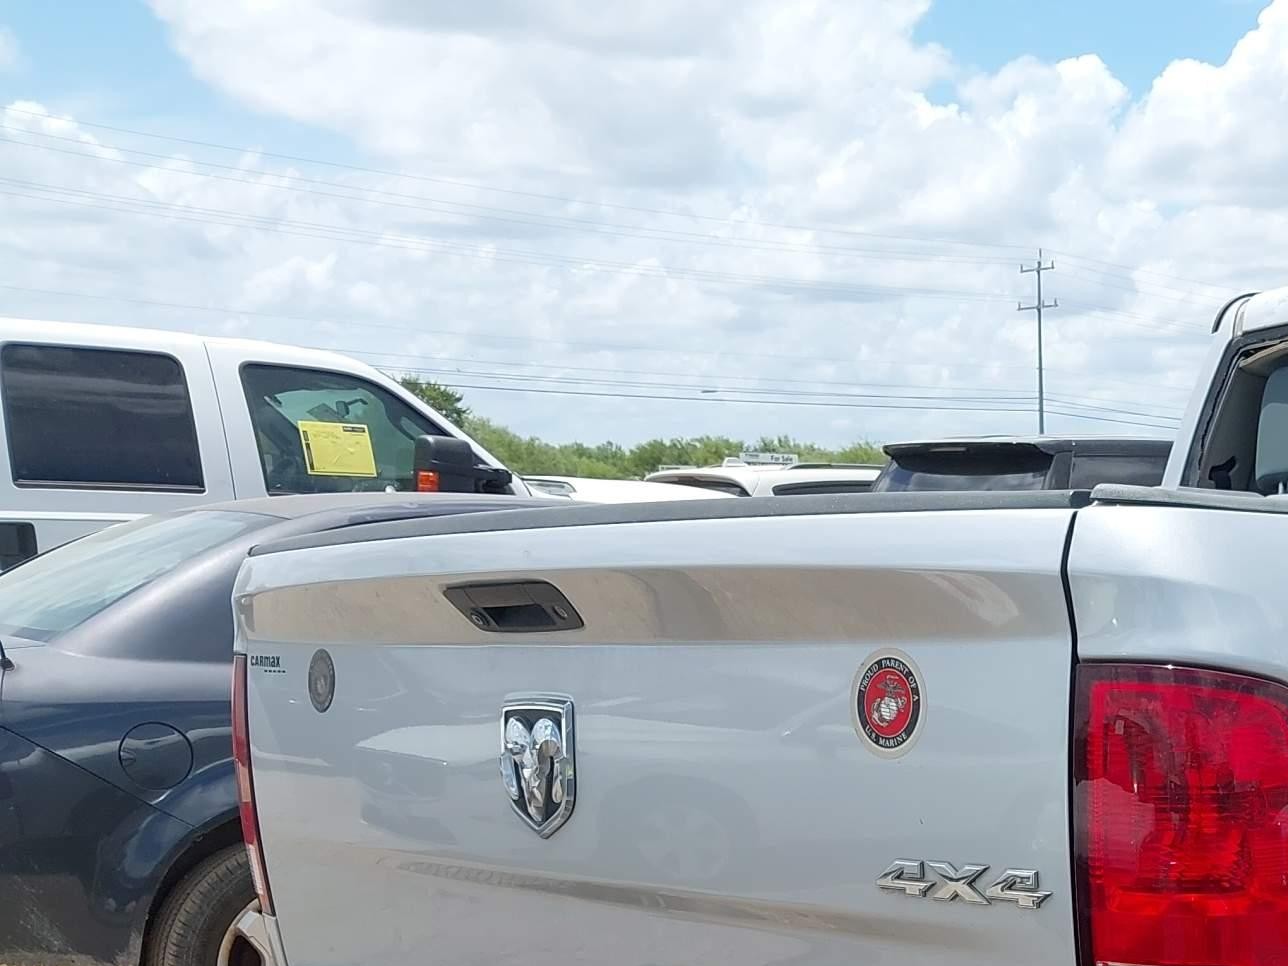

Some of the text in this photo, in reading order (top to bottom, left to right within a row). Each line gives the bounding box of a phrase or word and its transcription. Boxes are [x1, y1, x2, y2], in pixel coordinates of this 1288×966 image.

[781, 455, 793, 463] Sale
[860, 663, 880, 691] PROUD
[881, 659, 909, 674] PARENT
[908, 676, 918, 689] OF
[878, 733, 908, 747] MARINE
